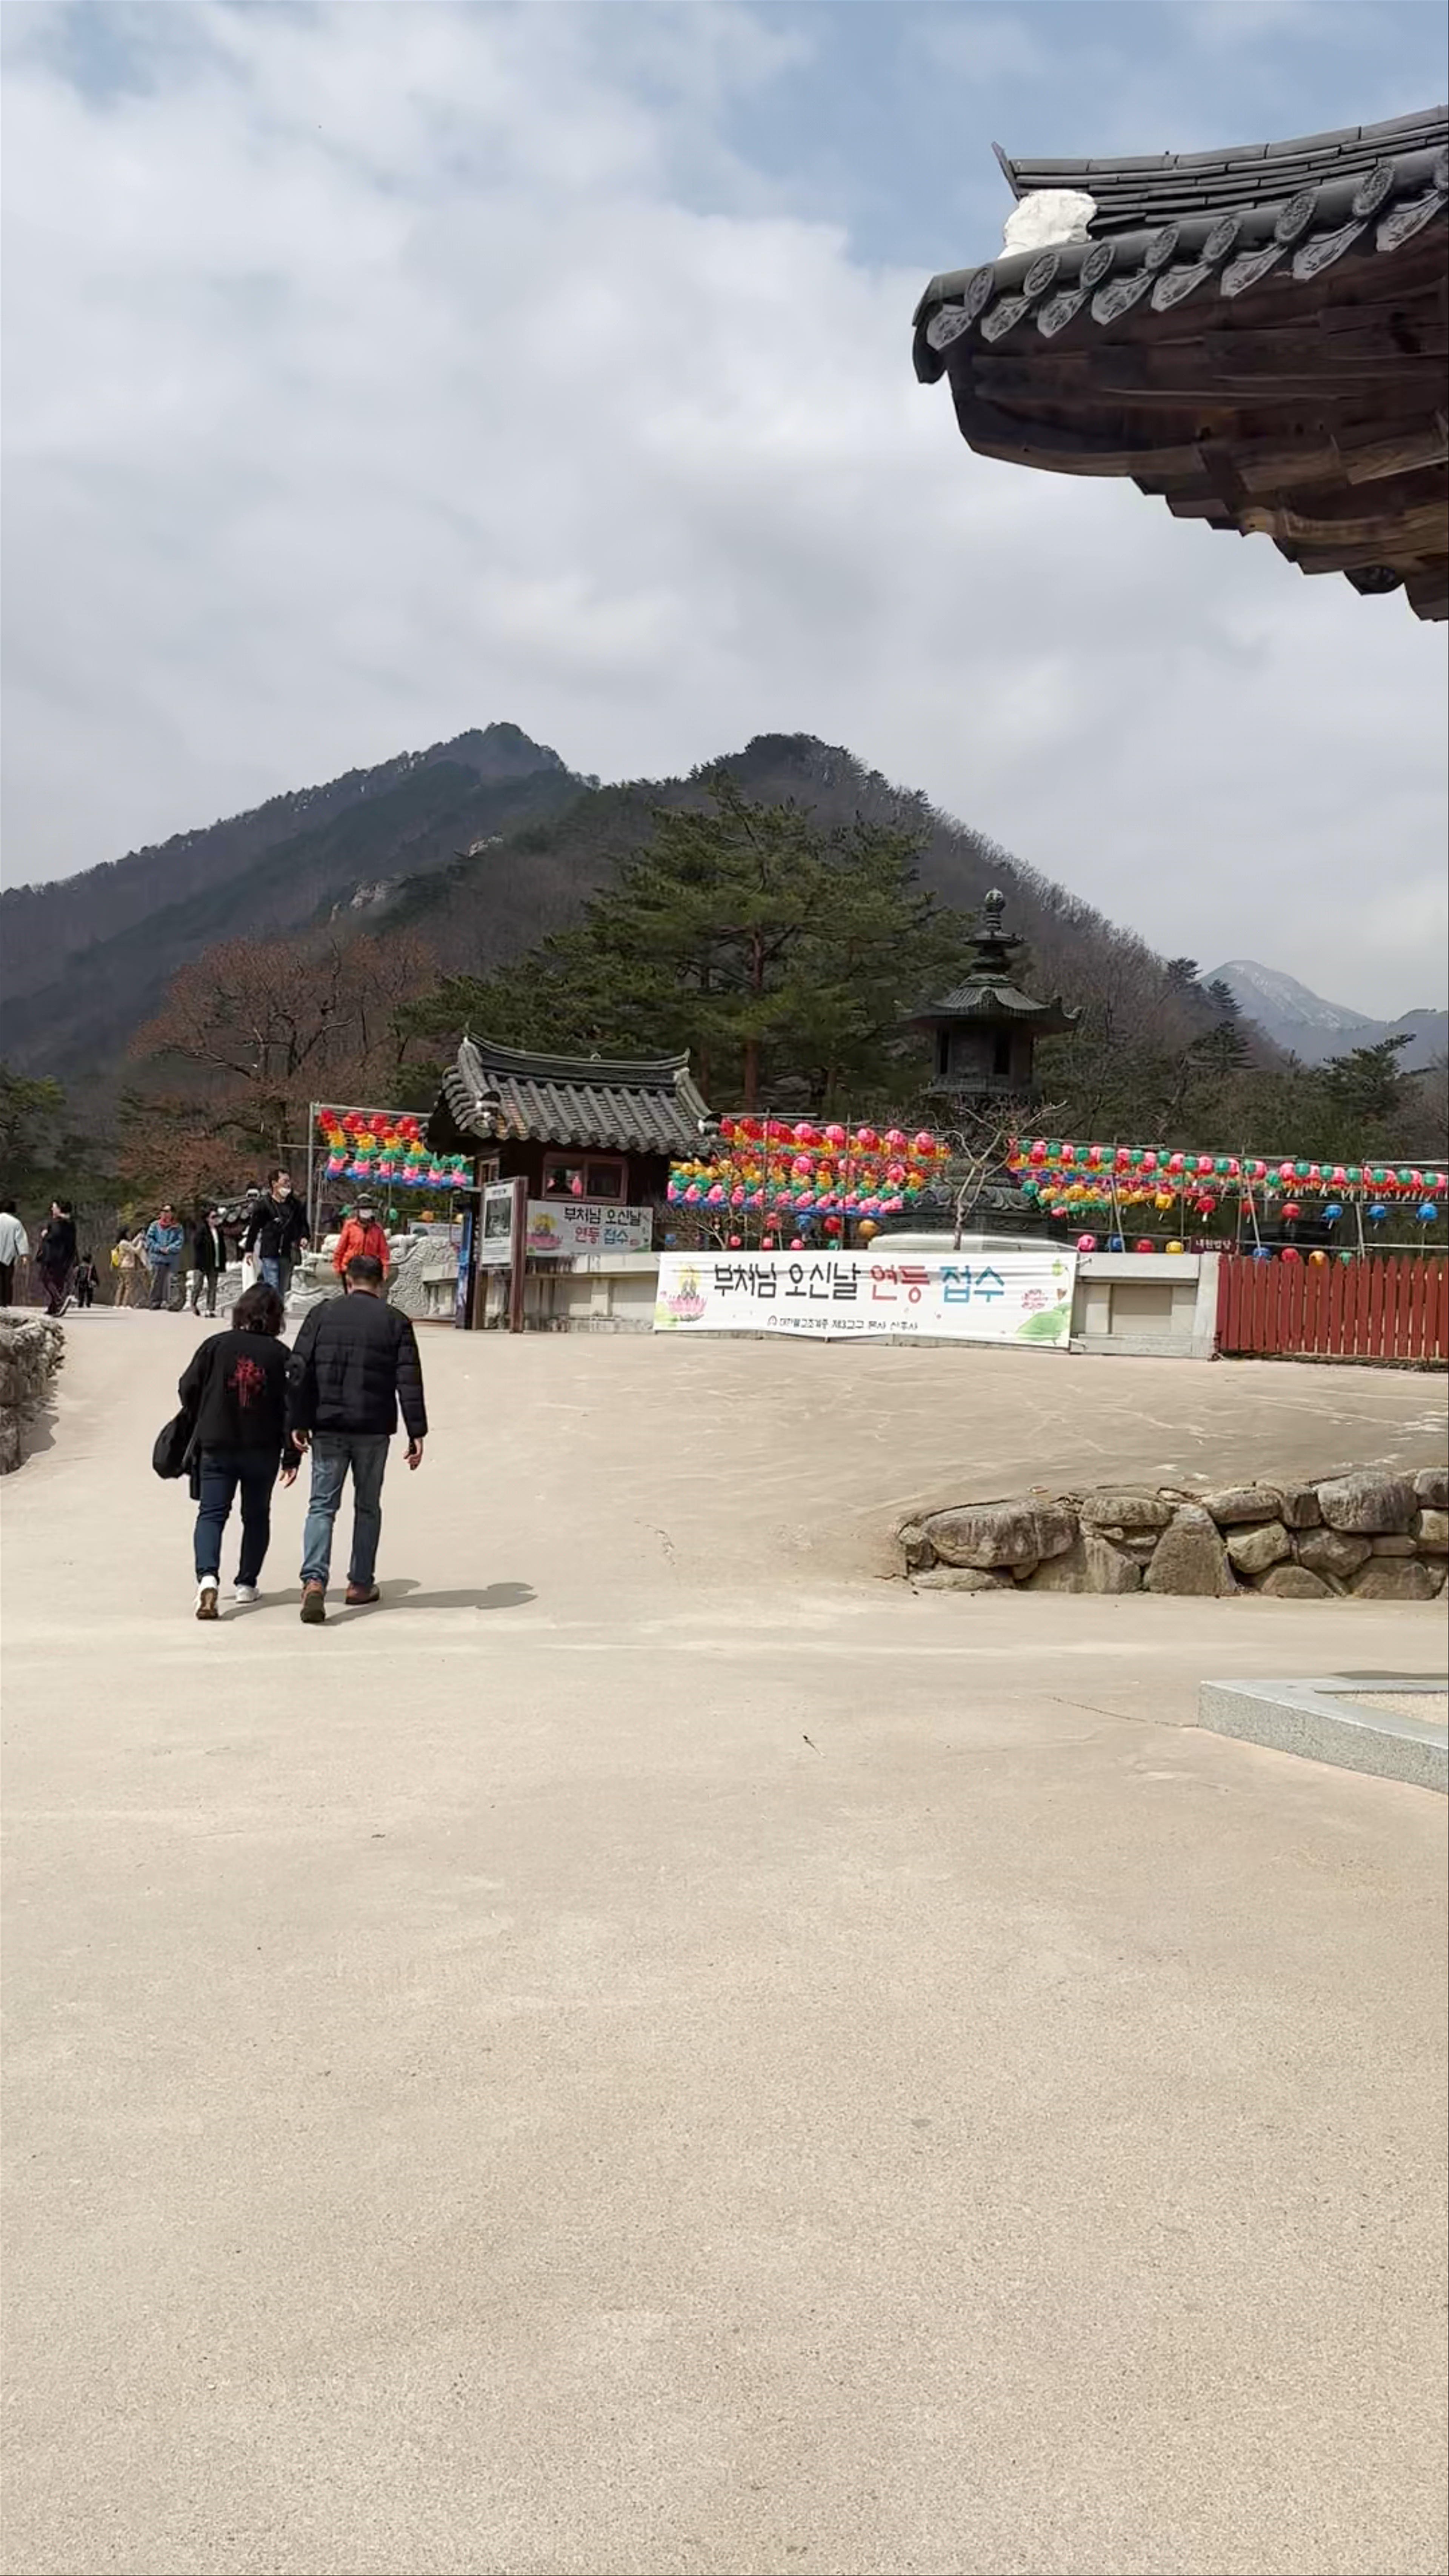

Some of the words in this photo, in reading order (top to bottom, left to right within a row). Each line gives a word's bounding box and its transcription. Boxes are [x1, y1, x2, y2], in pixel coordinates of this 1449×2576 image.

[564, 1207, 601, 1224] 부처님
[606, 1209, 640, 1226] 오신날
[575, 1227, 600, 1244] 연등
[605, 1228, 628, 1245] 접수
[714, 1263, 777, 1298] 부처님
[785, 1262, 861, 1300] 오신날
[871, 1265, 930, 1304] 연등
[940, 1265, 1005, 1303] 접수
[832, 1319, 864, 1329] 제3교구
[868, 1321, 886, 1330] 본사
